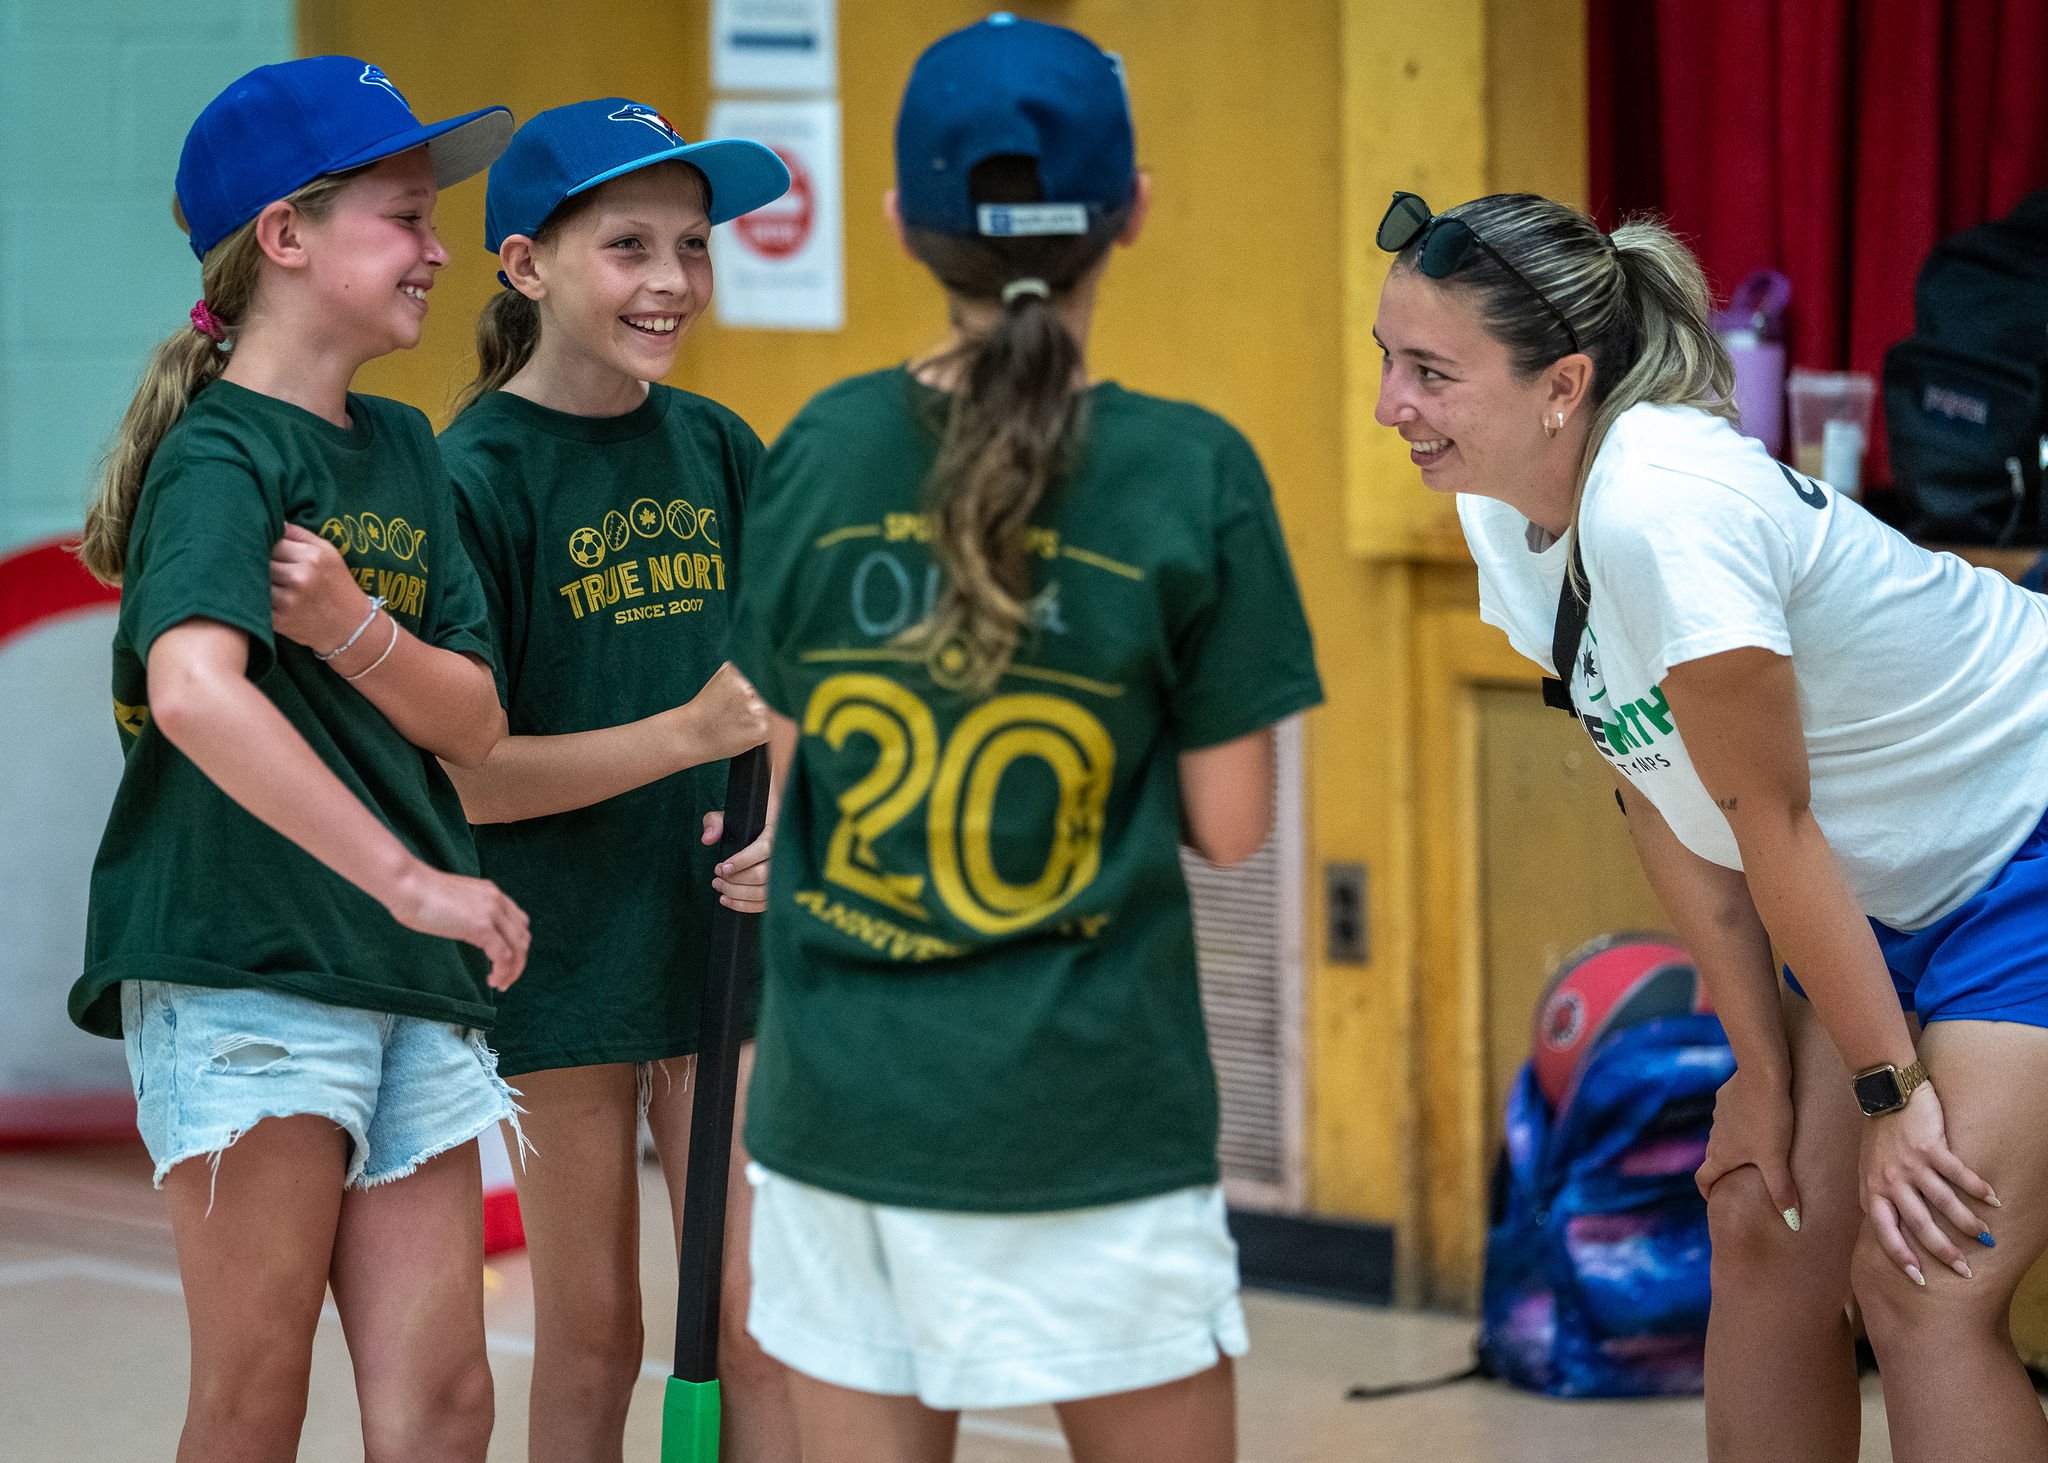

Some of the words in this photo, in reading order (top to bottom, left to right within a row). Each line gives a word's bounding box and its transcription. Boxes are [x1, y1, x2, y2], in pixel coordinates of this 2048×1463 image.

[378, 569, 428, 618] NORT
[559, 560, 645, 620] TRUE
[648, 552, 726, 594] NORT
[614, 604, 666, 625] SINCE
[668, 599, 704, 615] 2007
[803, 672, 1116, 934] 20
